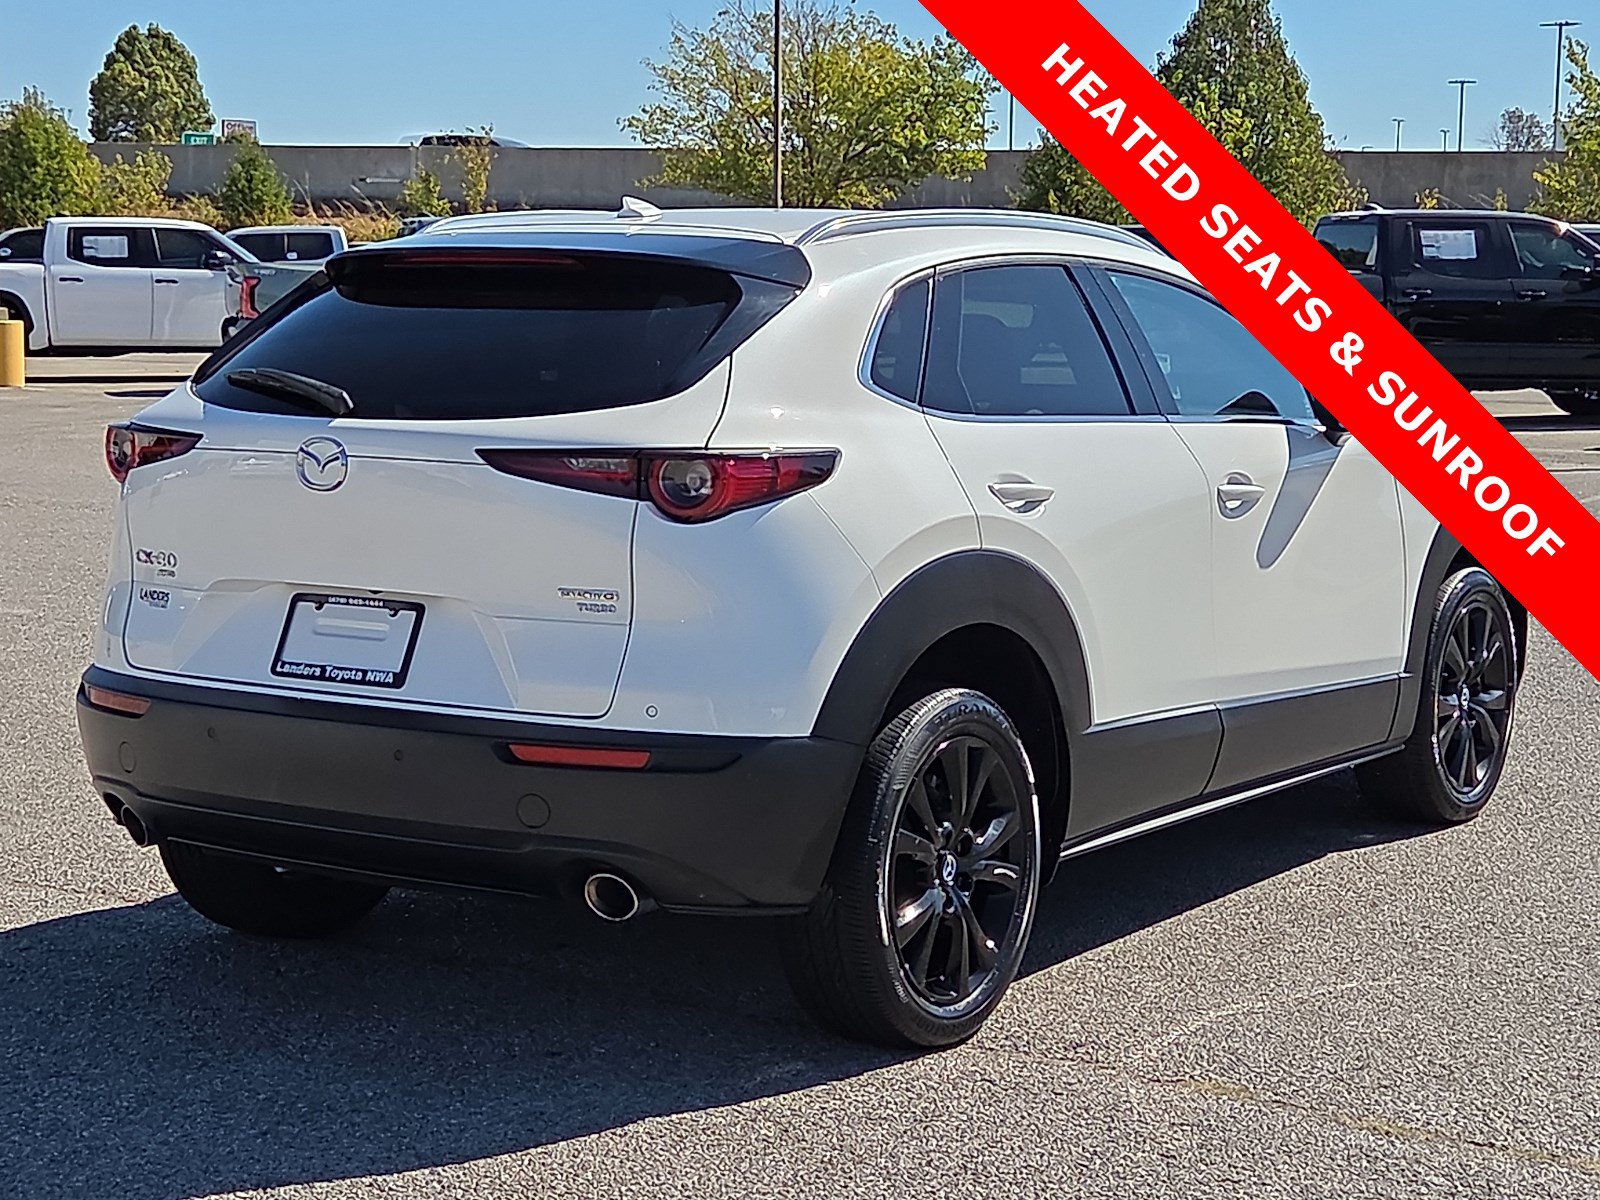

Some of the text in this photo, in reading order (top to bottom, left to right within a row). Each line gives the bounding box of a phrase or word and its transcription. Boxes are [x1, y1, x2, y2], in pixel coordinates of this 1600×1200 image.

[136, 548, 177, 568] CX-30
[275, 661, 394, 684] Landers Toyota NWA
